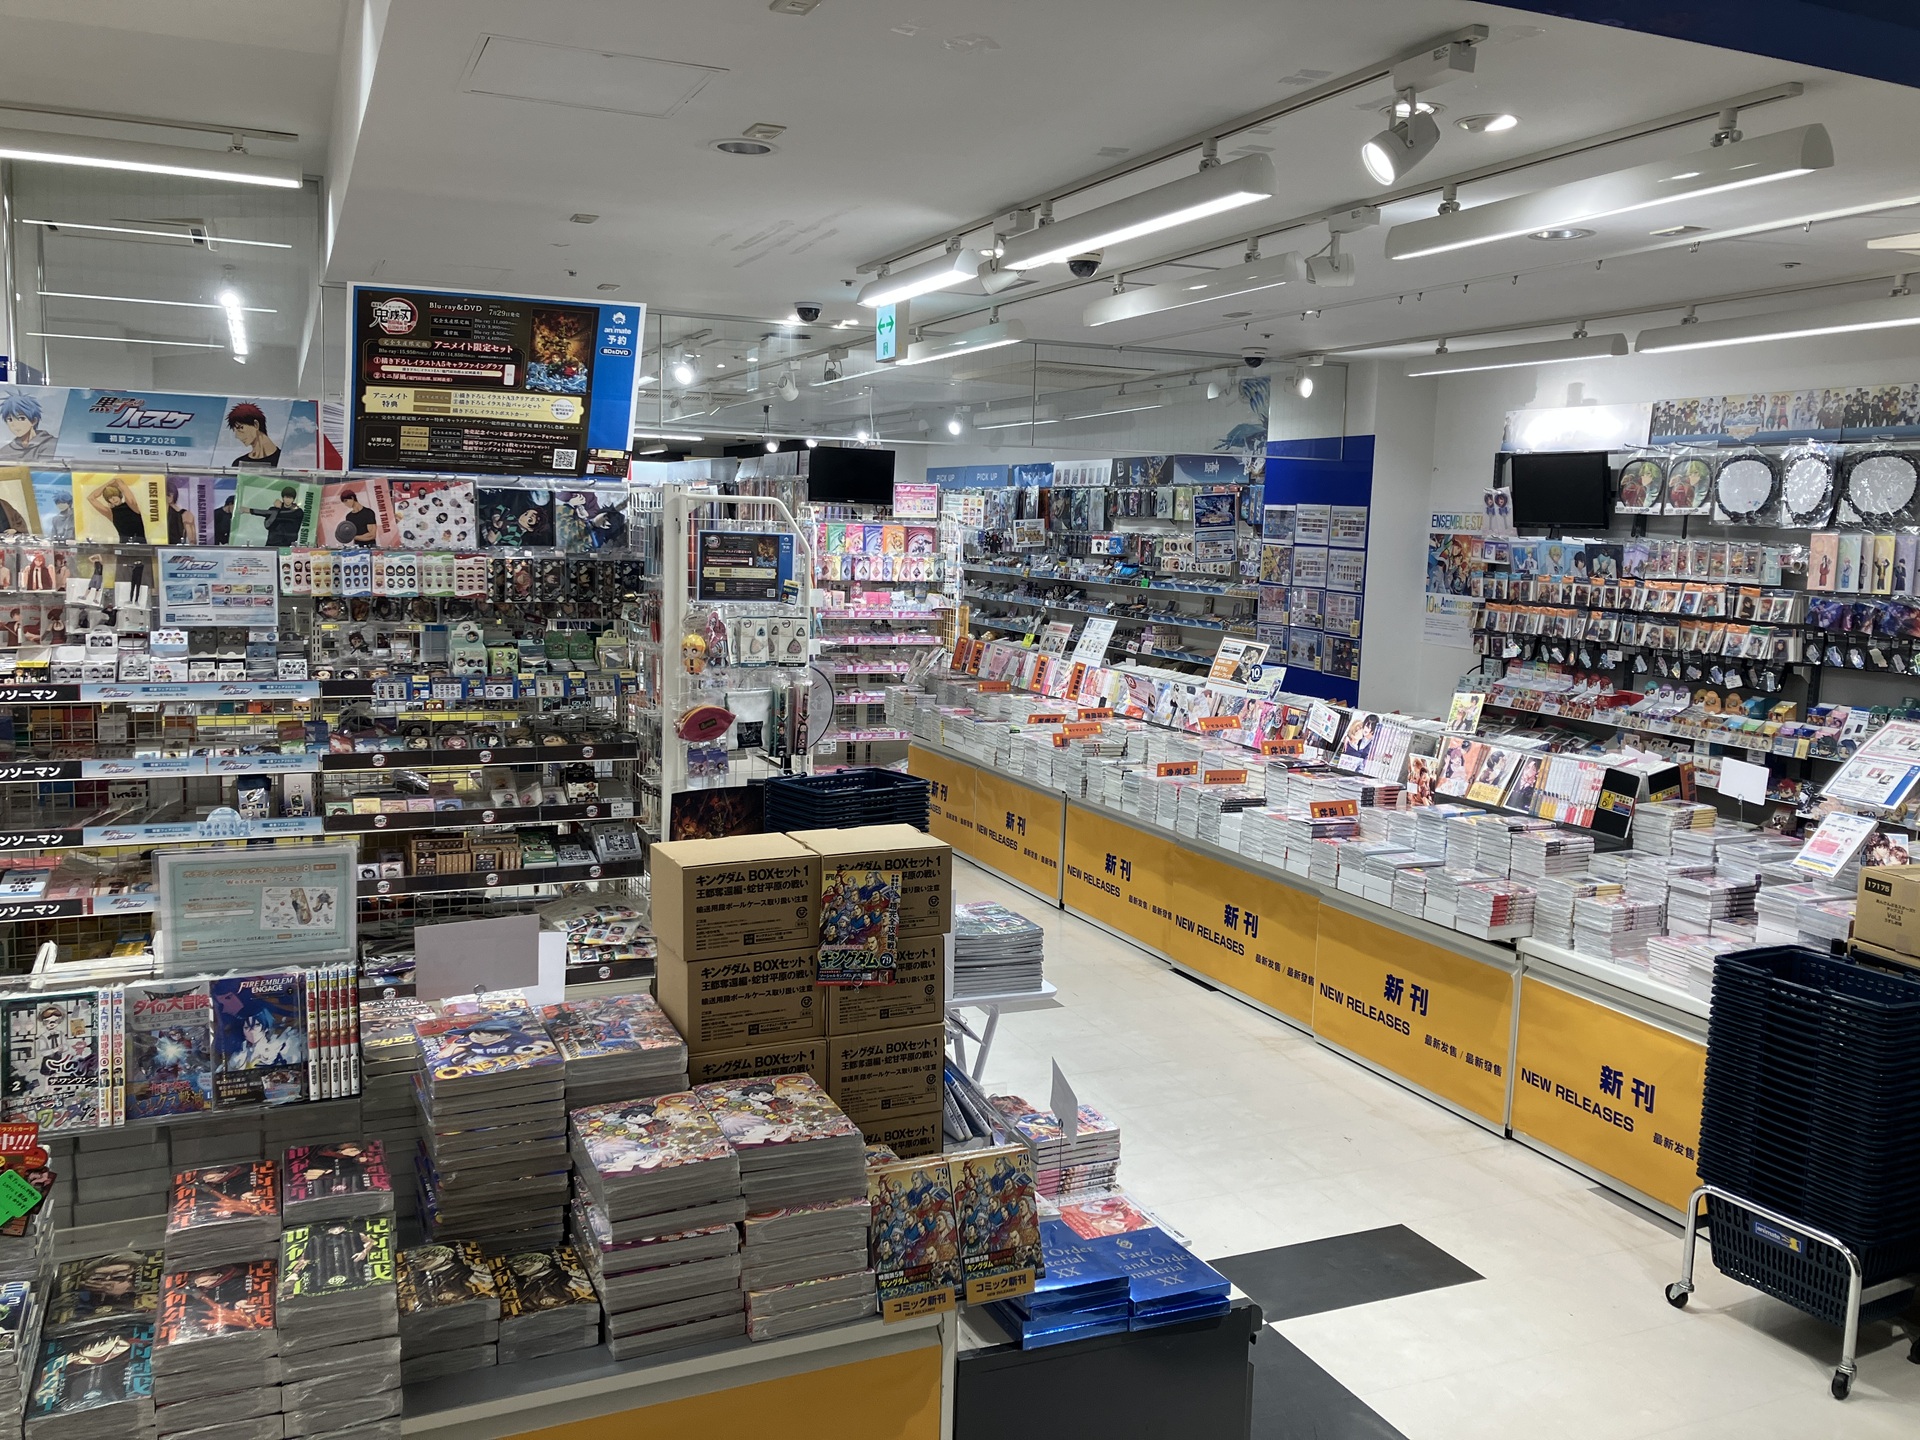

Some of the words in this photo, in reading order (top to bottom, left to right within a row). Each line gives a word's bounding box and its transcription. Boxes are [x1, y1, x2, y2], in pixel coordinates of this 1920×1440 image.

[429, 302, 482, 312] Blu-ray&DVD
[604, 326, 632, 334] animate
[434, 341, 513, 353] アニメイト限定セット
[607, 335, 627, 346] 予約
[382, 400, 398, 408] 特典
[109, 434, 176, 444] 初夏フェア2026
[976, 473, 988, 481] PICK
[990, 472, 998, 480] UP
[149, 482, 158, 498] KISE
[150, 500, 160, 523] RYOTA
[302, 491, 314, 527] MIDORIMA
[373, 484, 382, 509] KAGAMI
[381, 512, 390, 534] TAIGA
[1432, 514, 1471, 529] ENSEMBLE
[1252, 668, 1260, 678] 10
[931, 781, 948, 802] 新刊
[1320, 806, 1346, 818] 一迅社
[1006, 812, 1026, 836] 新刊
[976, 823, 988, 836] NEW
[988, 828, 1018, 850] RELEASES
[836, 862, 882, 870] キングダム
[884, 858, 933, 870] BOXセット
[936, 856, 940, 866] 1
[1105, 852, 1132, 882] 新刊
[696, 872, 746, 886] キングダム
[749, 866, 800, 881] BOXセット
[804, 865, 808, 876] 1
[1067, 864, 1082, 879] NEW
[1083, 872, 1120, 898] RELEASES
[1224, 904, 1259, 939] 新刊
[1176, 914, 1196, 932] NEW
[1196, 924, 1244, 956] RELEASES
[820, 950, 880, 968] キングダム
[932, 948, 936, 958] 1
[701, 963, 750, 979] キングダム
[754, 956, 806, 972] BOXセット
[809, 956, 814, 966] 1
[1256, 954, 1281, 972] 最新发售
[1287, 967, 1314, 986] 最新發售
[238, 981, 260, 994] FIRE
[260, 977, 293, 987] EMBLEM
[252, 984, 283, 994] ENGAGE
[133, 994, 210, 1015] ダイの大冒険
[1384, 974, 1430, 1017] 新刊
[1320, 982, 1344, 1004] NEW
[1346, 996, 1410, 1036] RELEASES
[841, 1047, 884, 1060] キングダム
[886, 1038, 930, 1052] BOXセット
[933, 1038, 938, 1048] 1
[1424, 1034, 1458, 1058] 最新发售
[1466, 1052, 1502, 1077] 最新發售
[434, 1060, 493, 1080] ONE
[496, 1048, 558, 1068] PIECE
[703, 1058, 752, 1075] キングダム
[755, 1051, 807, 1068] BOXセット
[810, 1050, 815, 1060] 1
[12, 1081, 21, 1091] 2
[1600, 1065, 1656, 1114] 新刊
[1521, 1068, 1552, 1093] NEW
[1556, 1083, 1634, 1133] RELEASES
[884, 1126, 928, 1140] BOXセット
[930, 1125, 936, 1135] 1
[1652, 1132, 1696, 1160] 最新发售
[1016, 1154, 1030, 1166] 79
[935, 1168, 948, 1180] 79
[1756, 1226, 1780, 1240] animate
[1050, 1245, 1096, 1257] Order
[1117, 1248, 1152, 1260] Fate/
[1150, 1254, 1193, 1265] Order
[1052, 1266, 1083, 1278] XX
[1131, 1262, 1188, 1280] material
[1156, 1274, 1186, 1286] XX
[976, 1274, 1027, 1293] コミック新刊
[894, 1294, 946, 1313] コミック新刊
